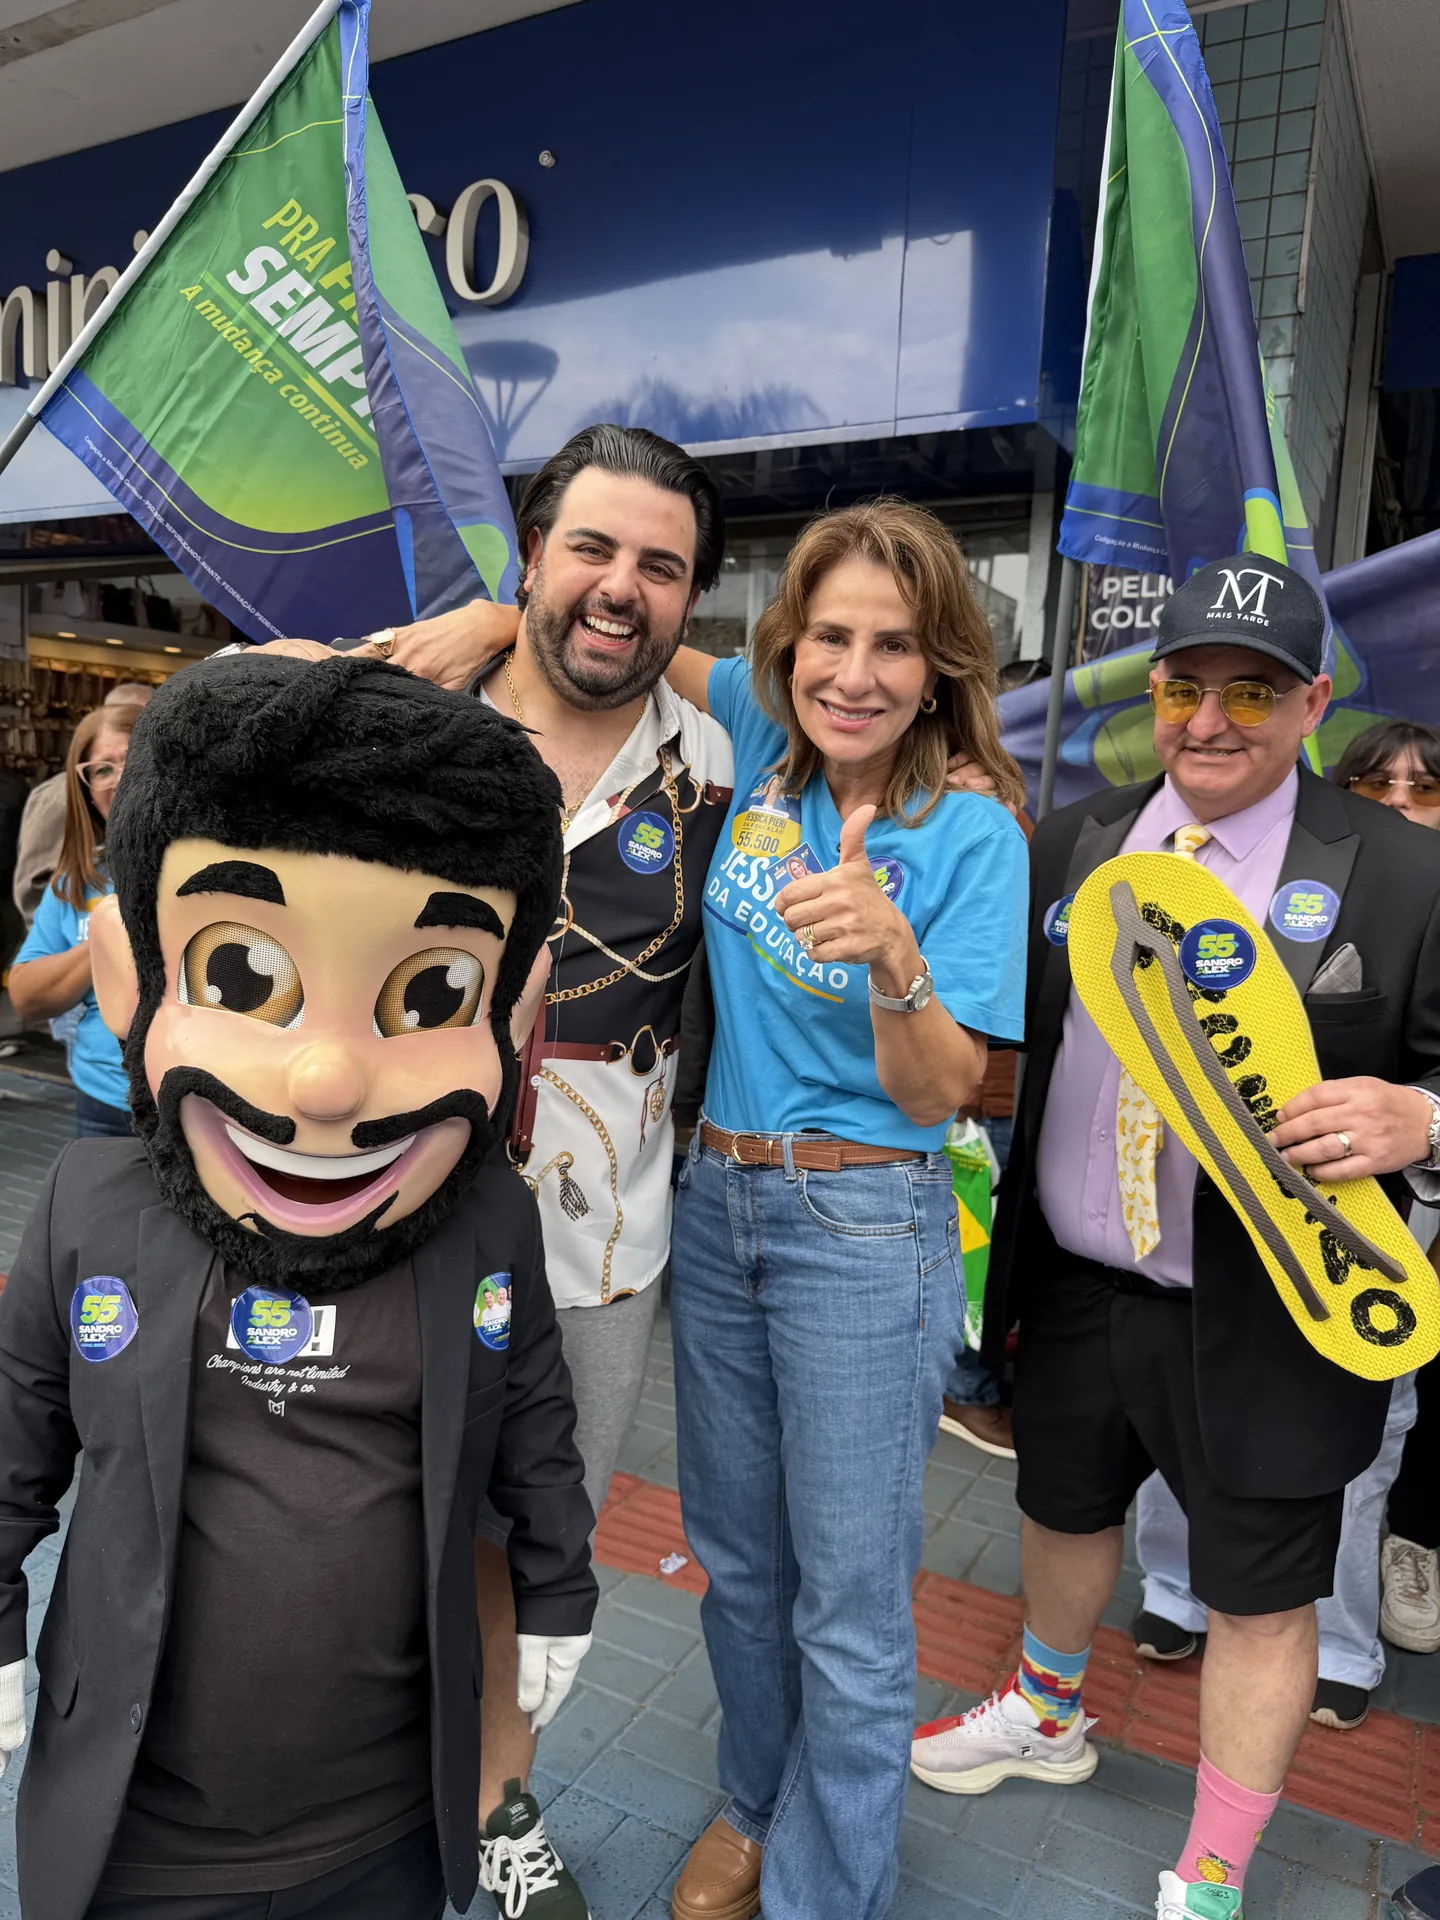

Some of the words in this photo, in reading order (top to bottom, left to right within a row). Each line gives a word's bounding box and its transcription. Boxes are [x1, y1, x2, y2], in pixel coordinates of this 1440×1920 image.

[262, 198, 337, 273] PRA
[226, 245, 376, 432] SEMP
[179, 285, 203, 302] A
[195, 299, 284, 385] mudança
[279, 383, 369, 470] continua
[1237, 613, 1270, 627] TARDE
[632, 822, 665, 849] 55
[736, 830, 780, 854] 55.500
[625, 847, 650, 861] ALEX
[628, 840, 663, 859] SANDRO
[707, 876, 730, 909] DA
[720, 848, 784, 921] JESS
[1287, 893, 1324, 915] 55
[1284, 913, 1329, 924] SANDRO
[1196, 933, 1235, 959] 55
[1195, 957, 1244, 968] SANDRO
[1195, 965, 1230, 975] ALEX
[80, 1295, 121, 1324] 55
[249, 1300, 291, 1327] 55
[79, 1324, 123, 1334] SANDRO
[79, 1333, 107, 1342] ALEX
[246, 1335, 281, 1345] ALEX
[247, 1328, 298, 1338] SANDRO
[206, 1354, 263, 1373] Champions
[264, 1364, 286, 1376] are
[286, 1366, 307, 1379] not
[306, 1364, 351, 1380] limited
[240, 1375, 287, 1397] Industry
[287, 1382, 298, 1394] &
